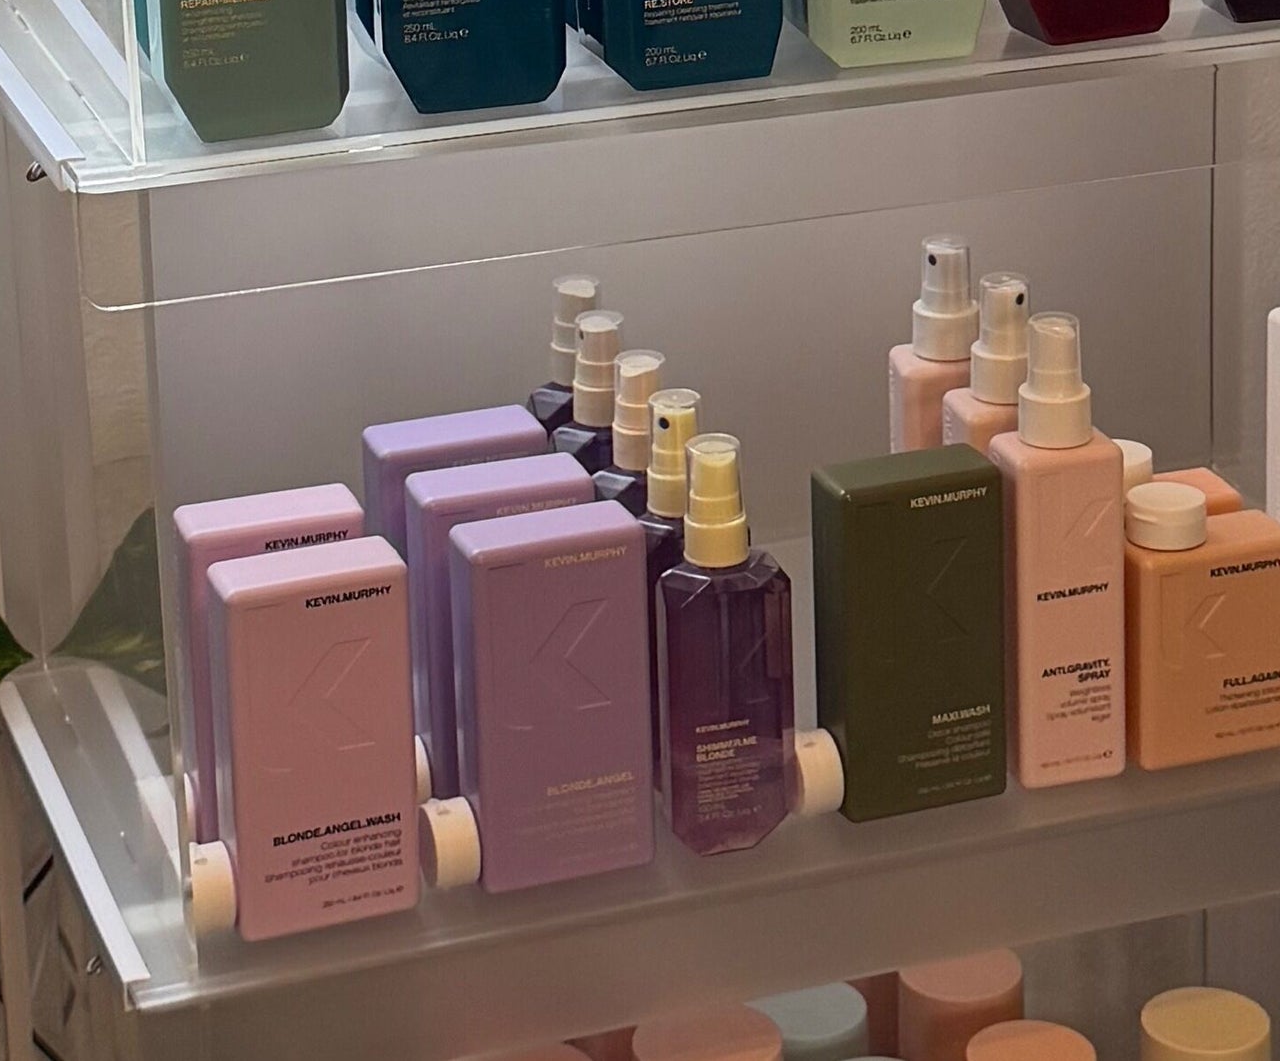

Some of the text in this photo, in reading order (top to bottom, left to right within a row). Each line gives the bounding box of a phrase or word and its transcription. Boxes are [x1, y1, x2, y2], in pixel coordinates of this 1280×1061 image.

[910, 486, 988, 509] KEVIN.MURPHY
[265, 530, 349, 550] KEVIN.MURPHY
[544, 546, 627, 569] KEVIN.MURPHY
[305, 585, 392, 608] KEVIN.MURPHY
[1037, 582, 1109, 602] KEVIN.MURPHY
[1077, 669, 1111, 684] SPRAY
[696, 749, 736, 763] BLONDE
[273, 812, 401, 847] BLONDE.ANGEL.WASH
